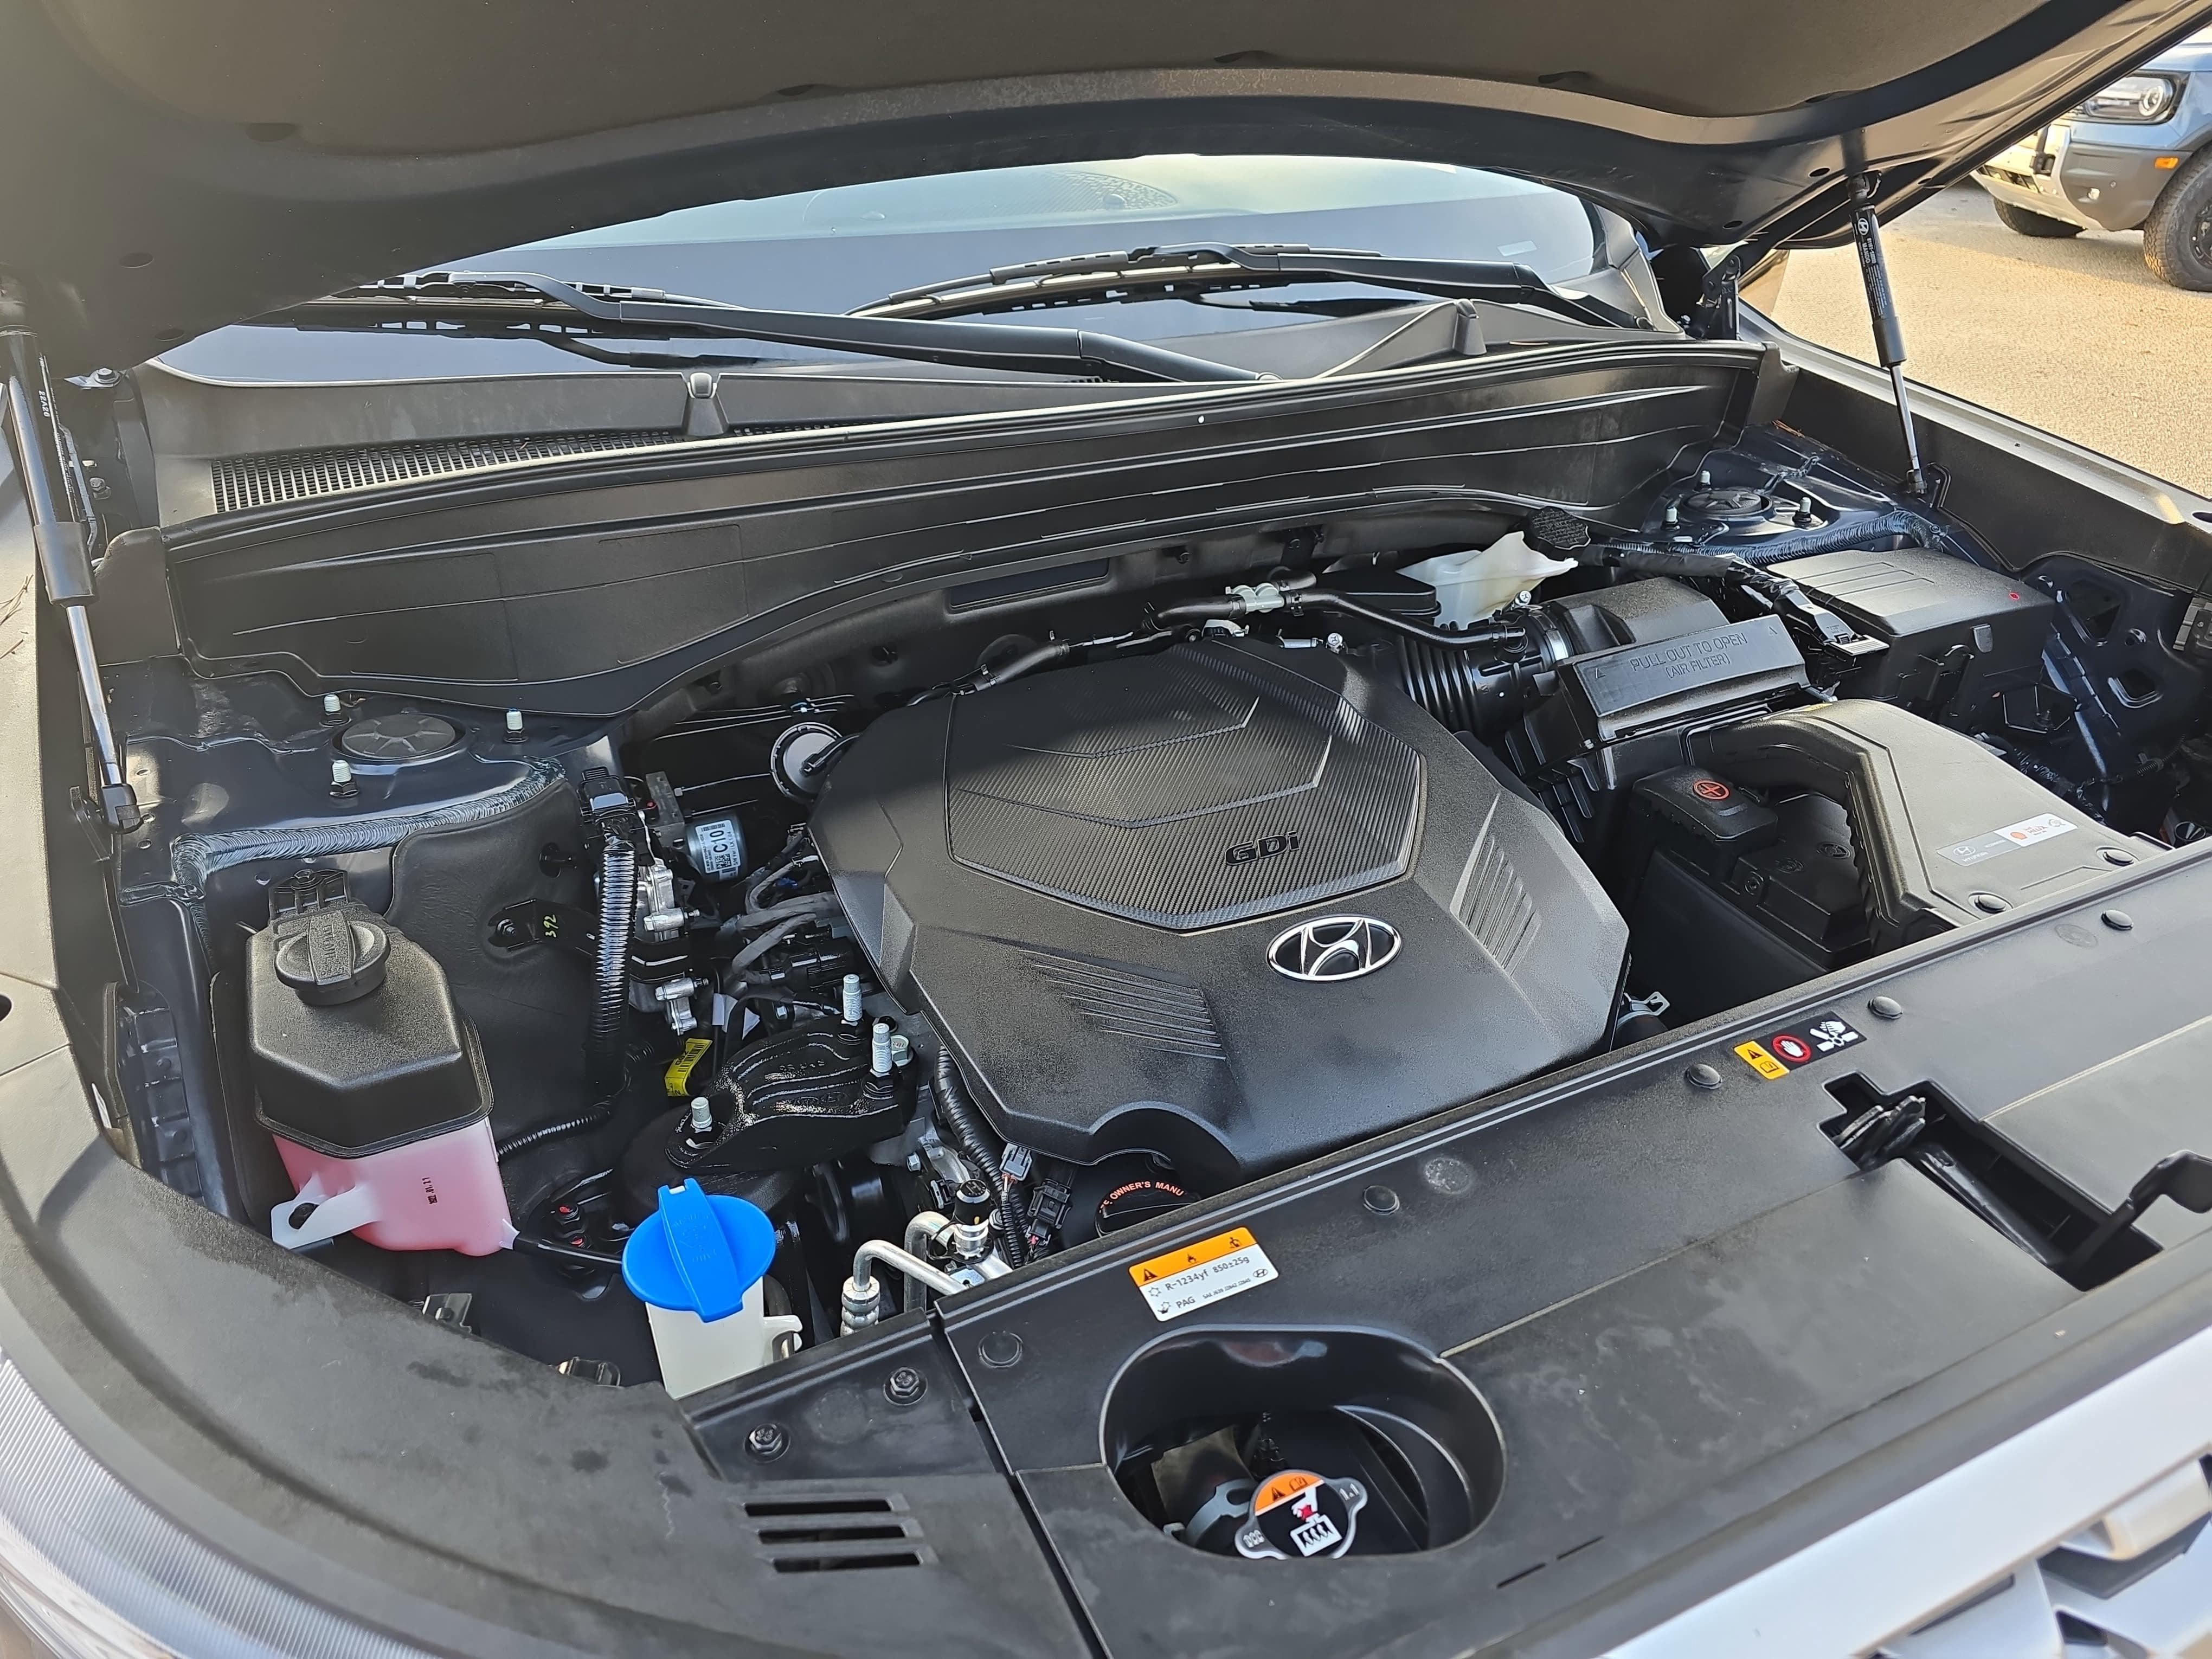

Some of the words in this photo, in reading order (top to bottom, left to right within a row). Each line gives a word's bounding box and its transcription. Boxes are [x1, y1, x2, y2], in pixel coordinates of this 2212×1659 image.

[1862, 242, 1871, 263] MANDO
[1630, 653, 1666, 672] PULL
[1664, 645, 1693, 662] OUT
[1693, 641, 1712, 654] TO
[1713, 633, 1748, 650] OPEN
[1665, 665, 1690, 679] (AIR
[1692, 653, 1731, 672] FILTER)
[709, 830, 728, 853] C10
[1224, 831, 1300, 866] GDi
[543, 914, 559, 938] 392
[1109, 1181, 1151, 1200] OWNER'S
[1155, 1181, 1187, 1196] MANU
[1165, 1269, 1209, 1290] R-1234yf
[1212, 1256, 1250, 1273] 850±25g
[1176, 1296, 1195, 1308] PAG
